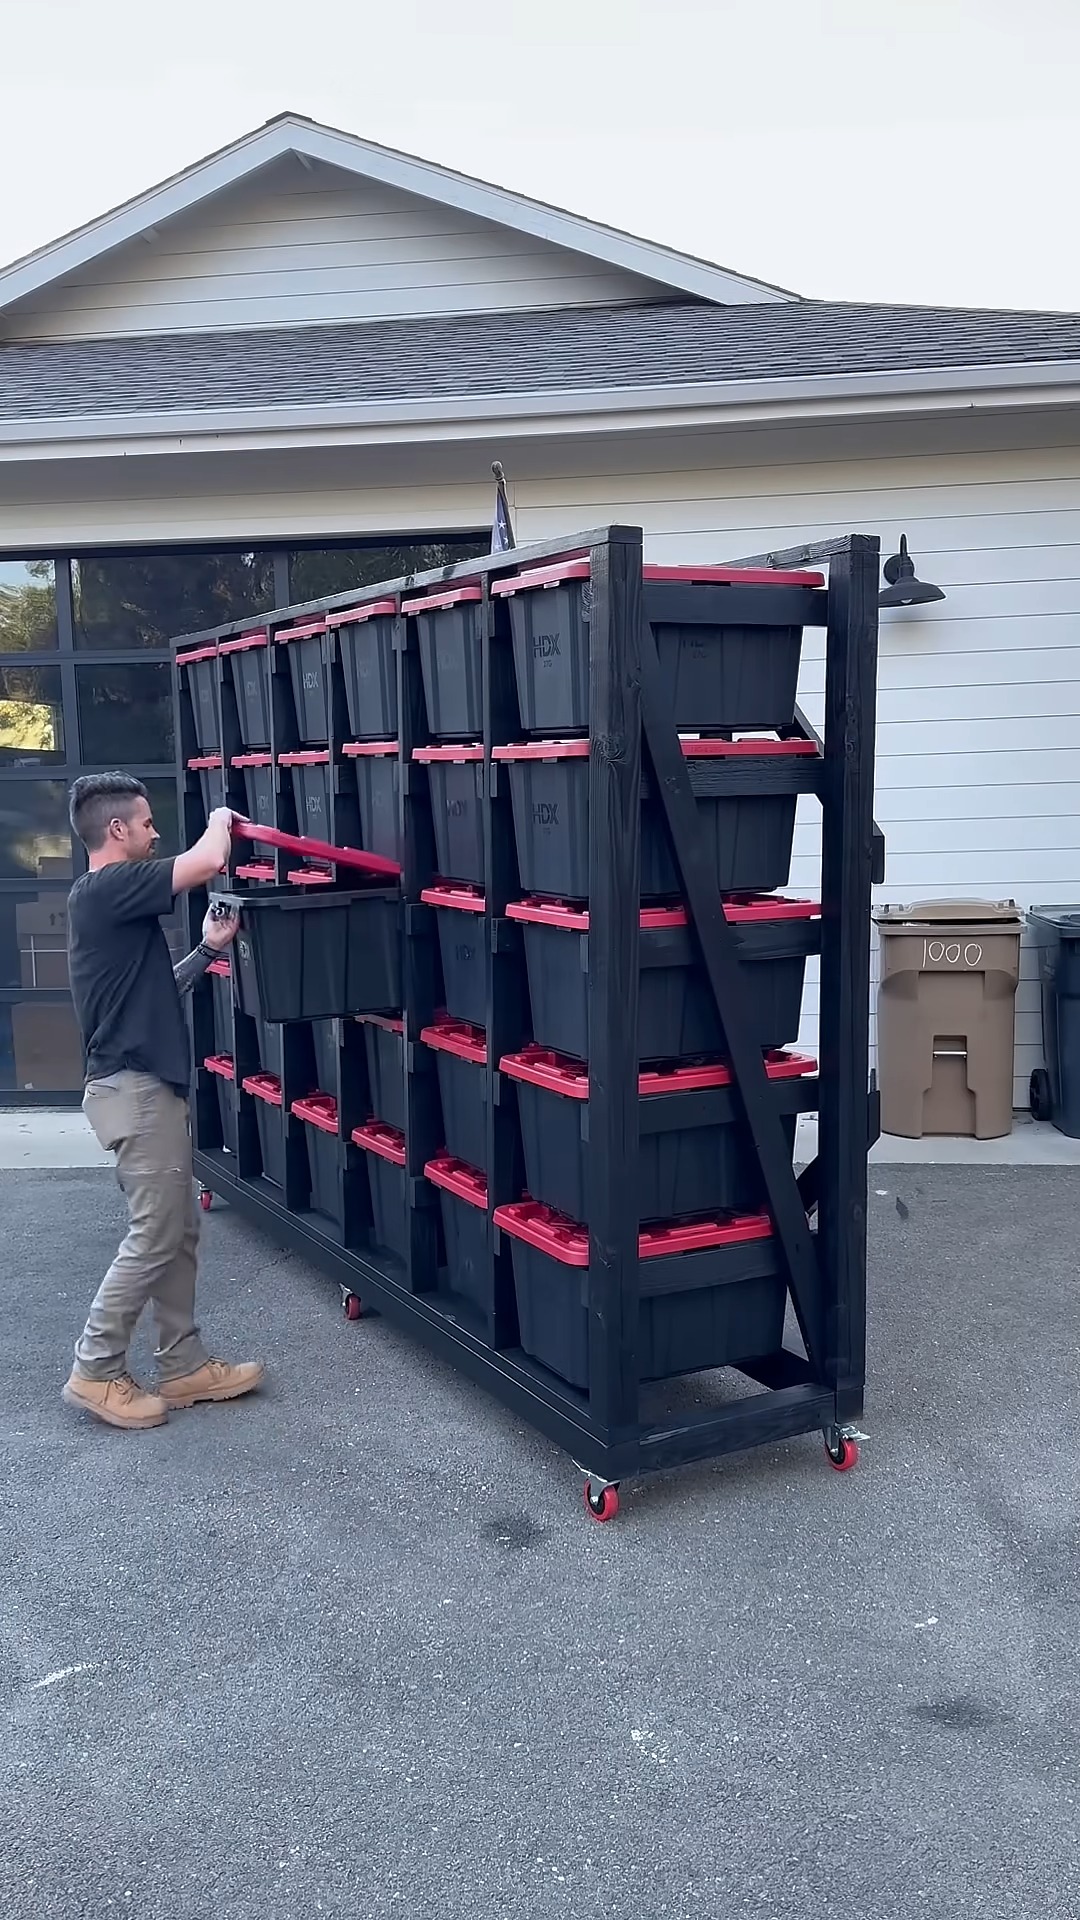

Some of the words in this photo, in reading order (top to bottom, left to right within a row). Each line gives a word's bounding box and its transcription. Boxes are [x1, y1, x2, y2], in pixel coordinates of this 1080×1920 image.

[533, 633, 561, 658] HDX
[302, 672, 319, 689] HDX
[305, 796, 322, 813] HDX
[532, 803, 560, 825] HDX
[922, 938, 983, 967] 1000
